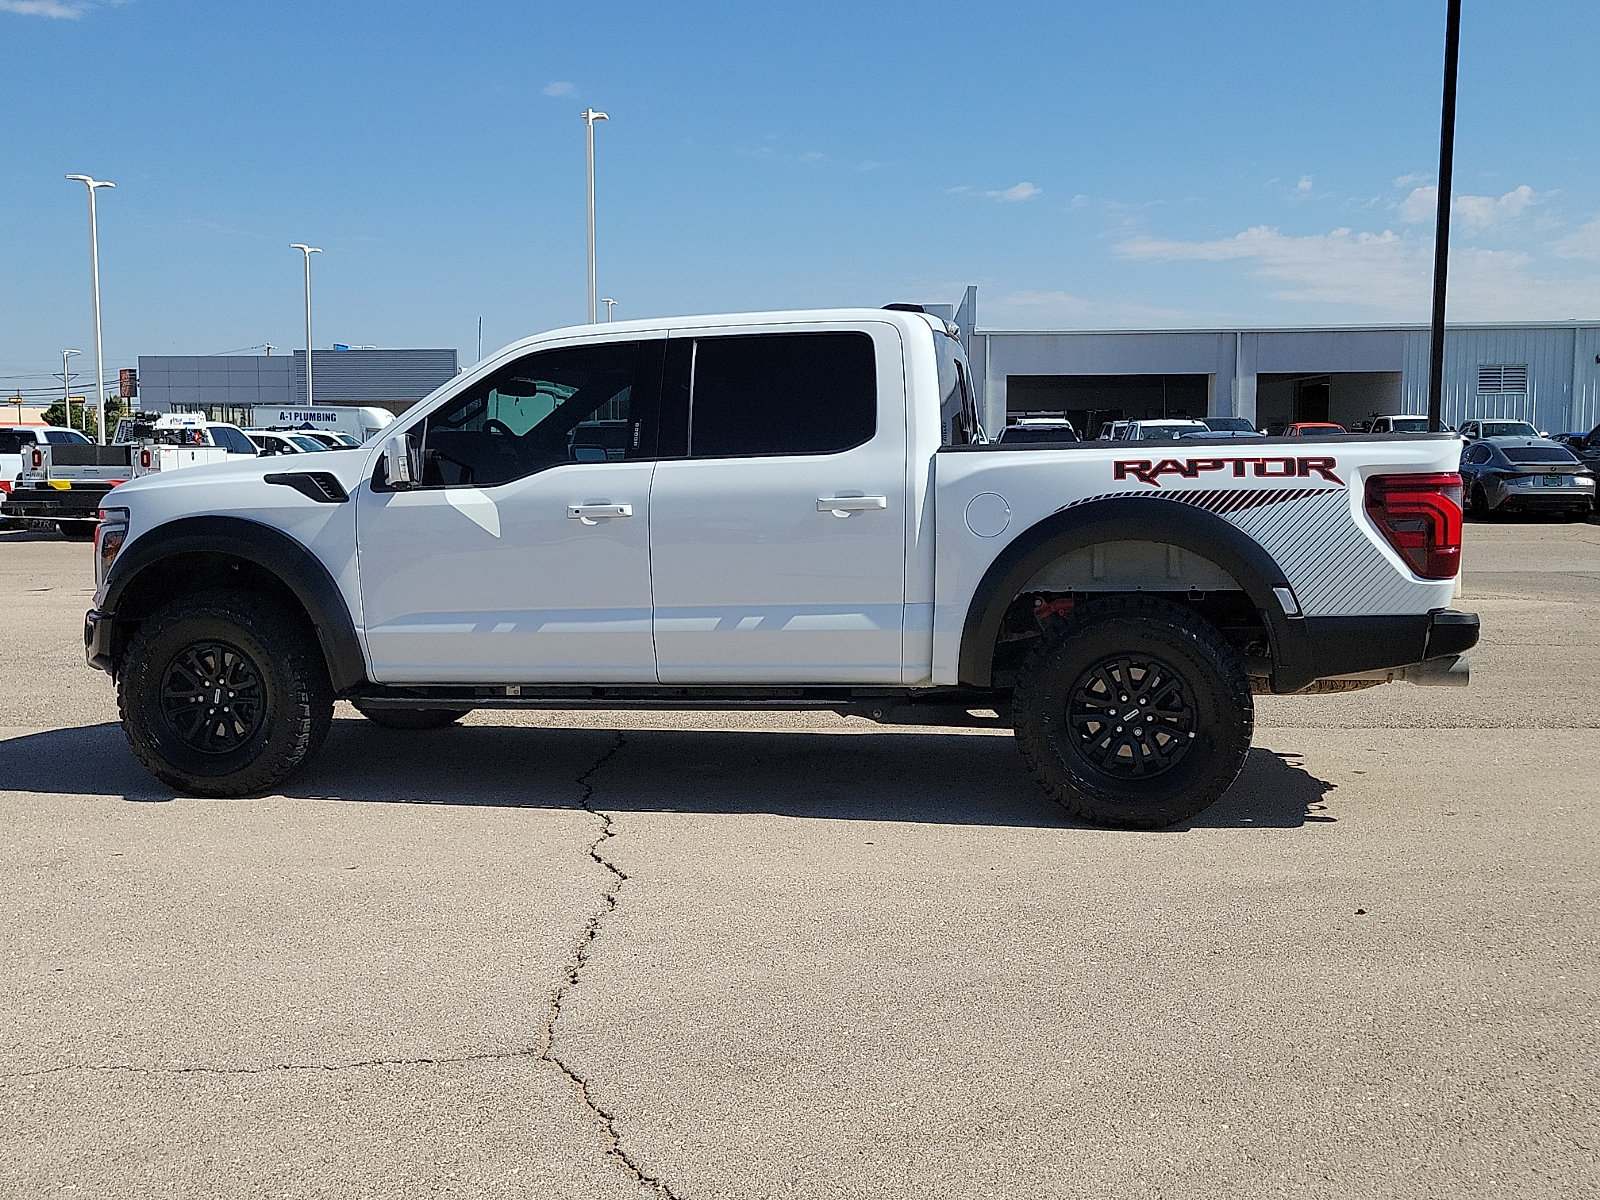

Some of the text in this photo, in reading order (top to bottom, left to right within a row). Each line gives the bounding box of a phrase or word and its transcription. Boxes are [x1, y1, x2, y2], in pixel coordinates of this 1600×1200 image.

[279, 411, 337, 422] A-1 PLUMBING
[1114, 456, 1346, 487] RAPTOR
